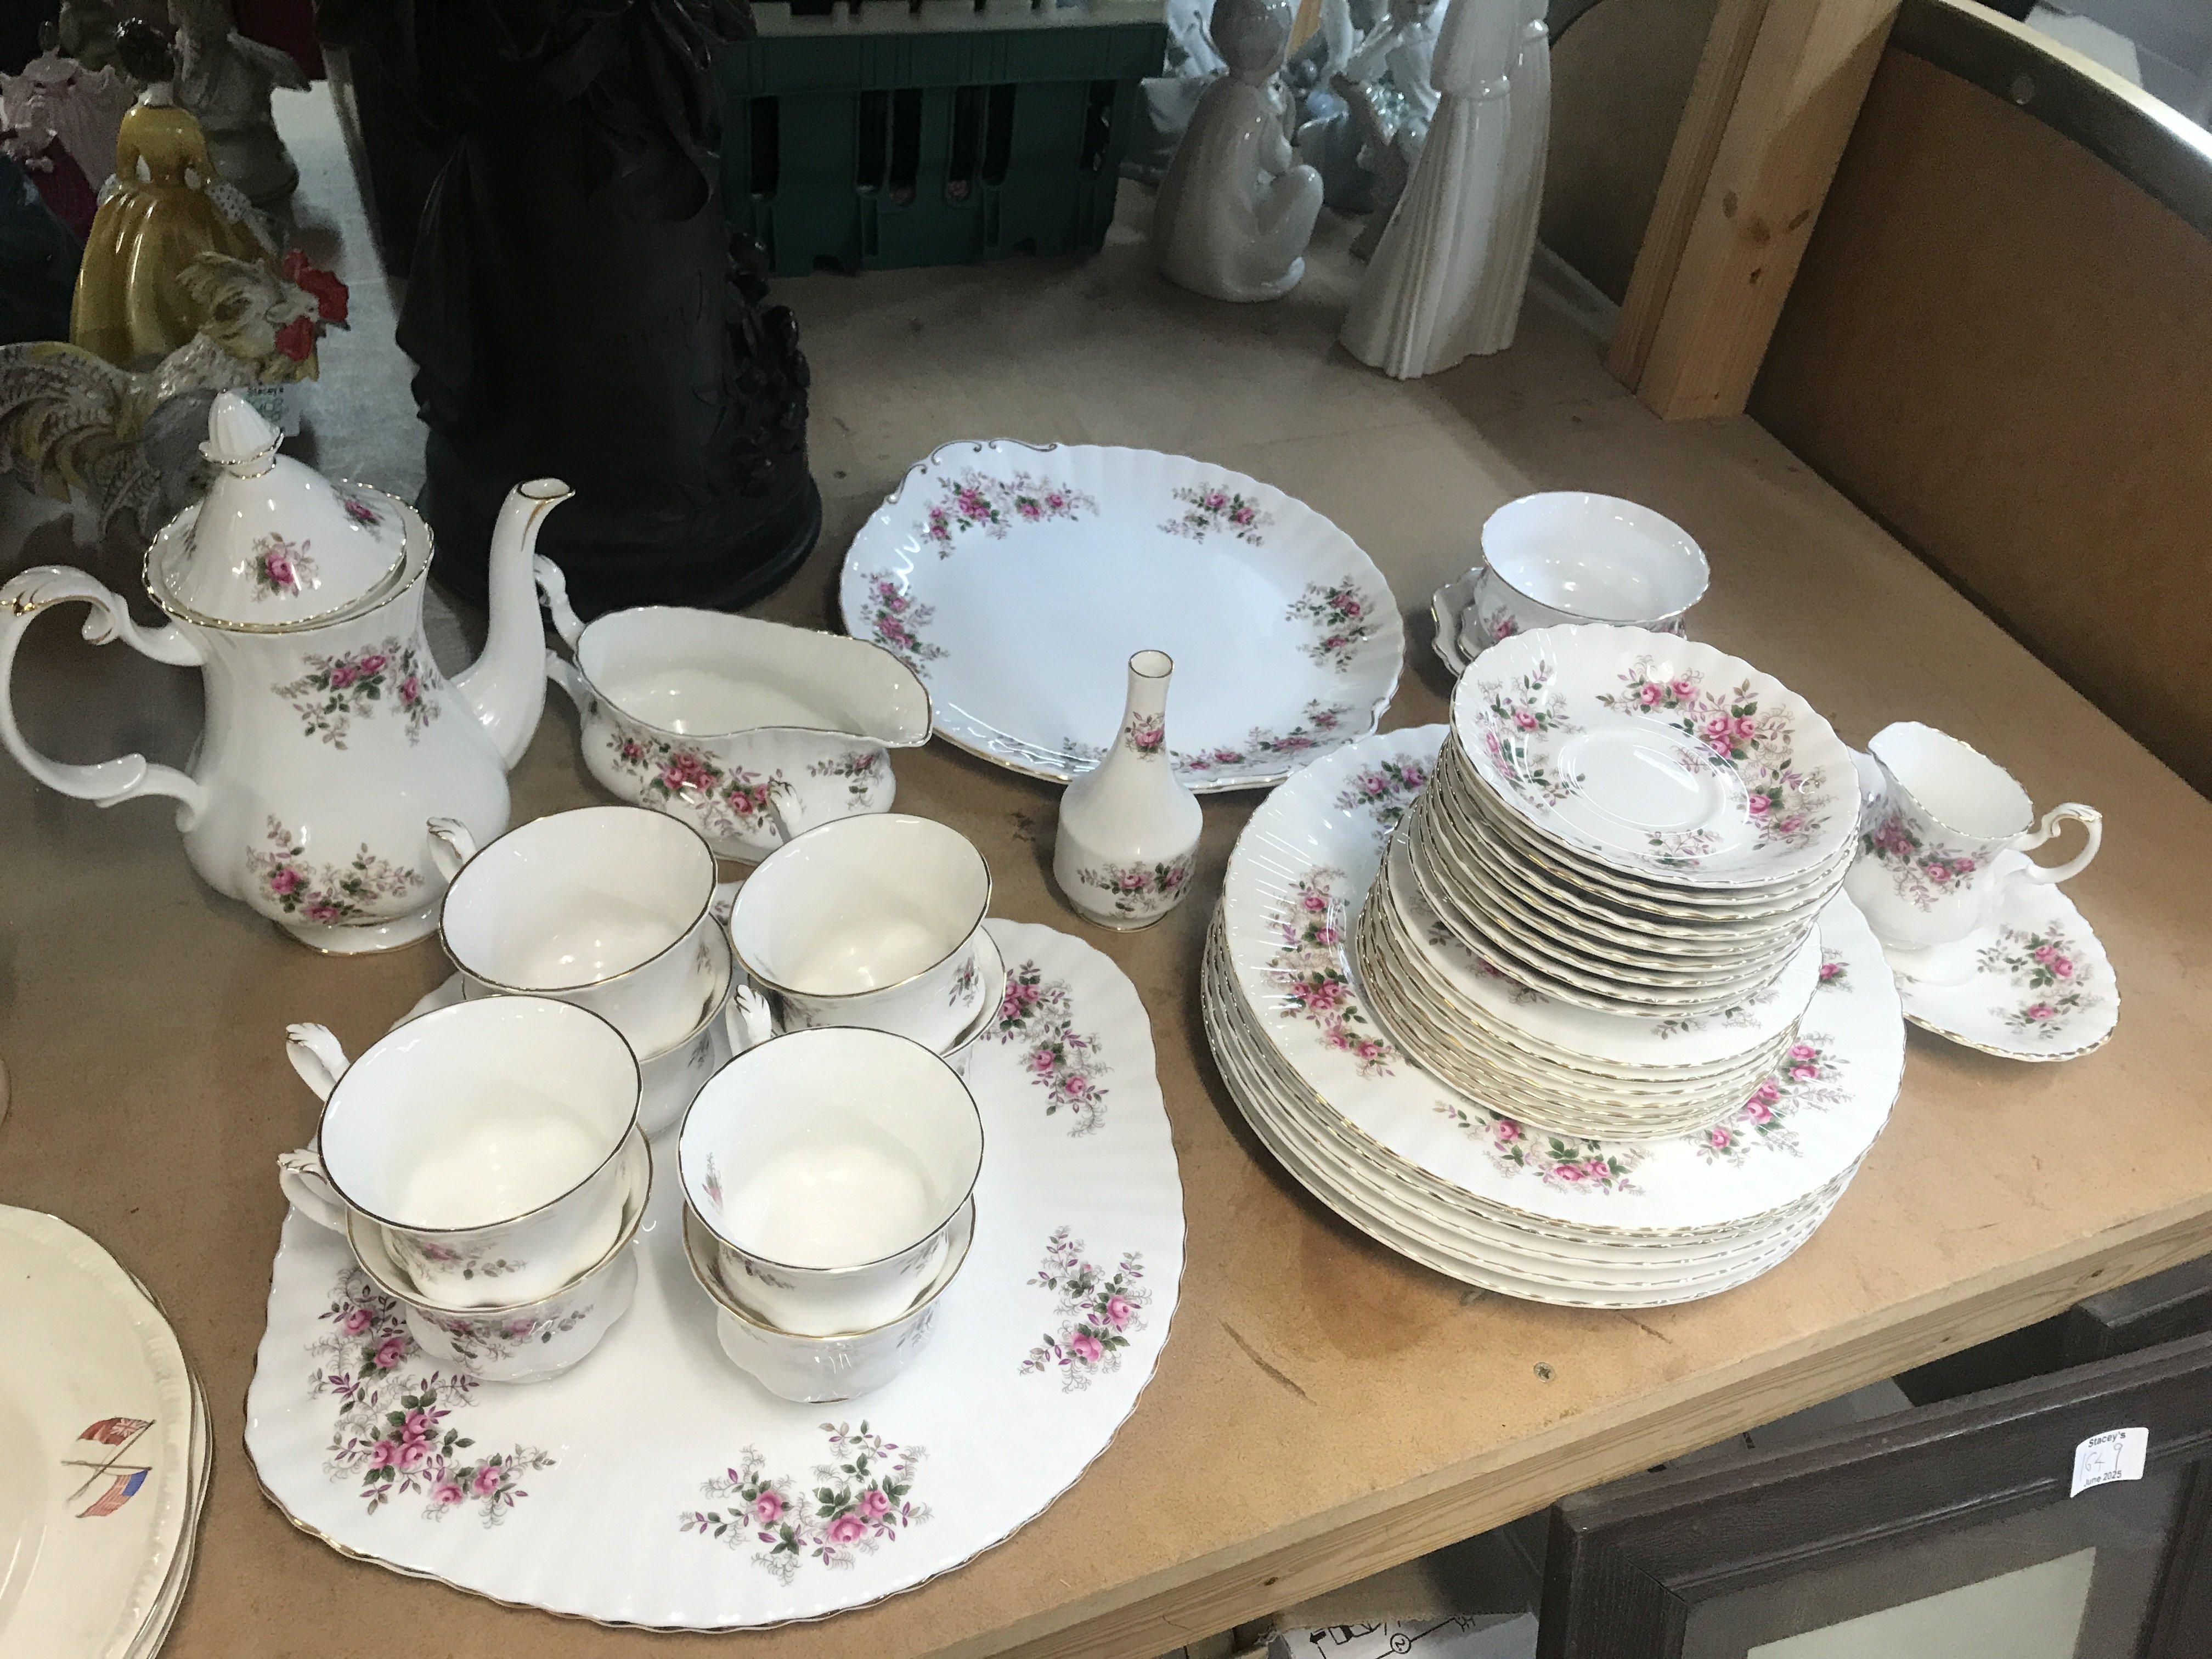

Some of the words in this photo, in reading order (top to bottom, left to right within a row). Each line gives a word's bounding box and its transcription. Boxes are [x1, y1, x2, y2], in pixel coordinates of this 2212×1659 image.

[2088, 1431, 2126, 1448] Stacey's
[2084, 1476, 2101, 1487] June
[2103, 1470, 2122, 1481] 2025
